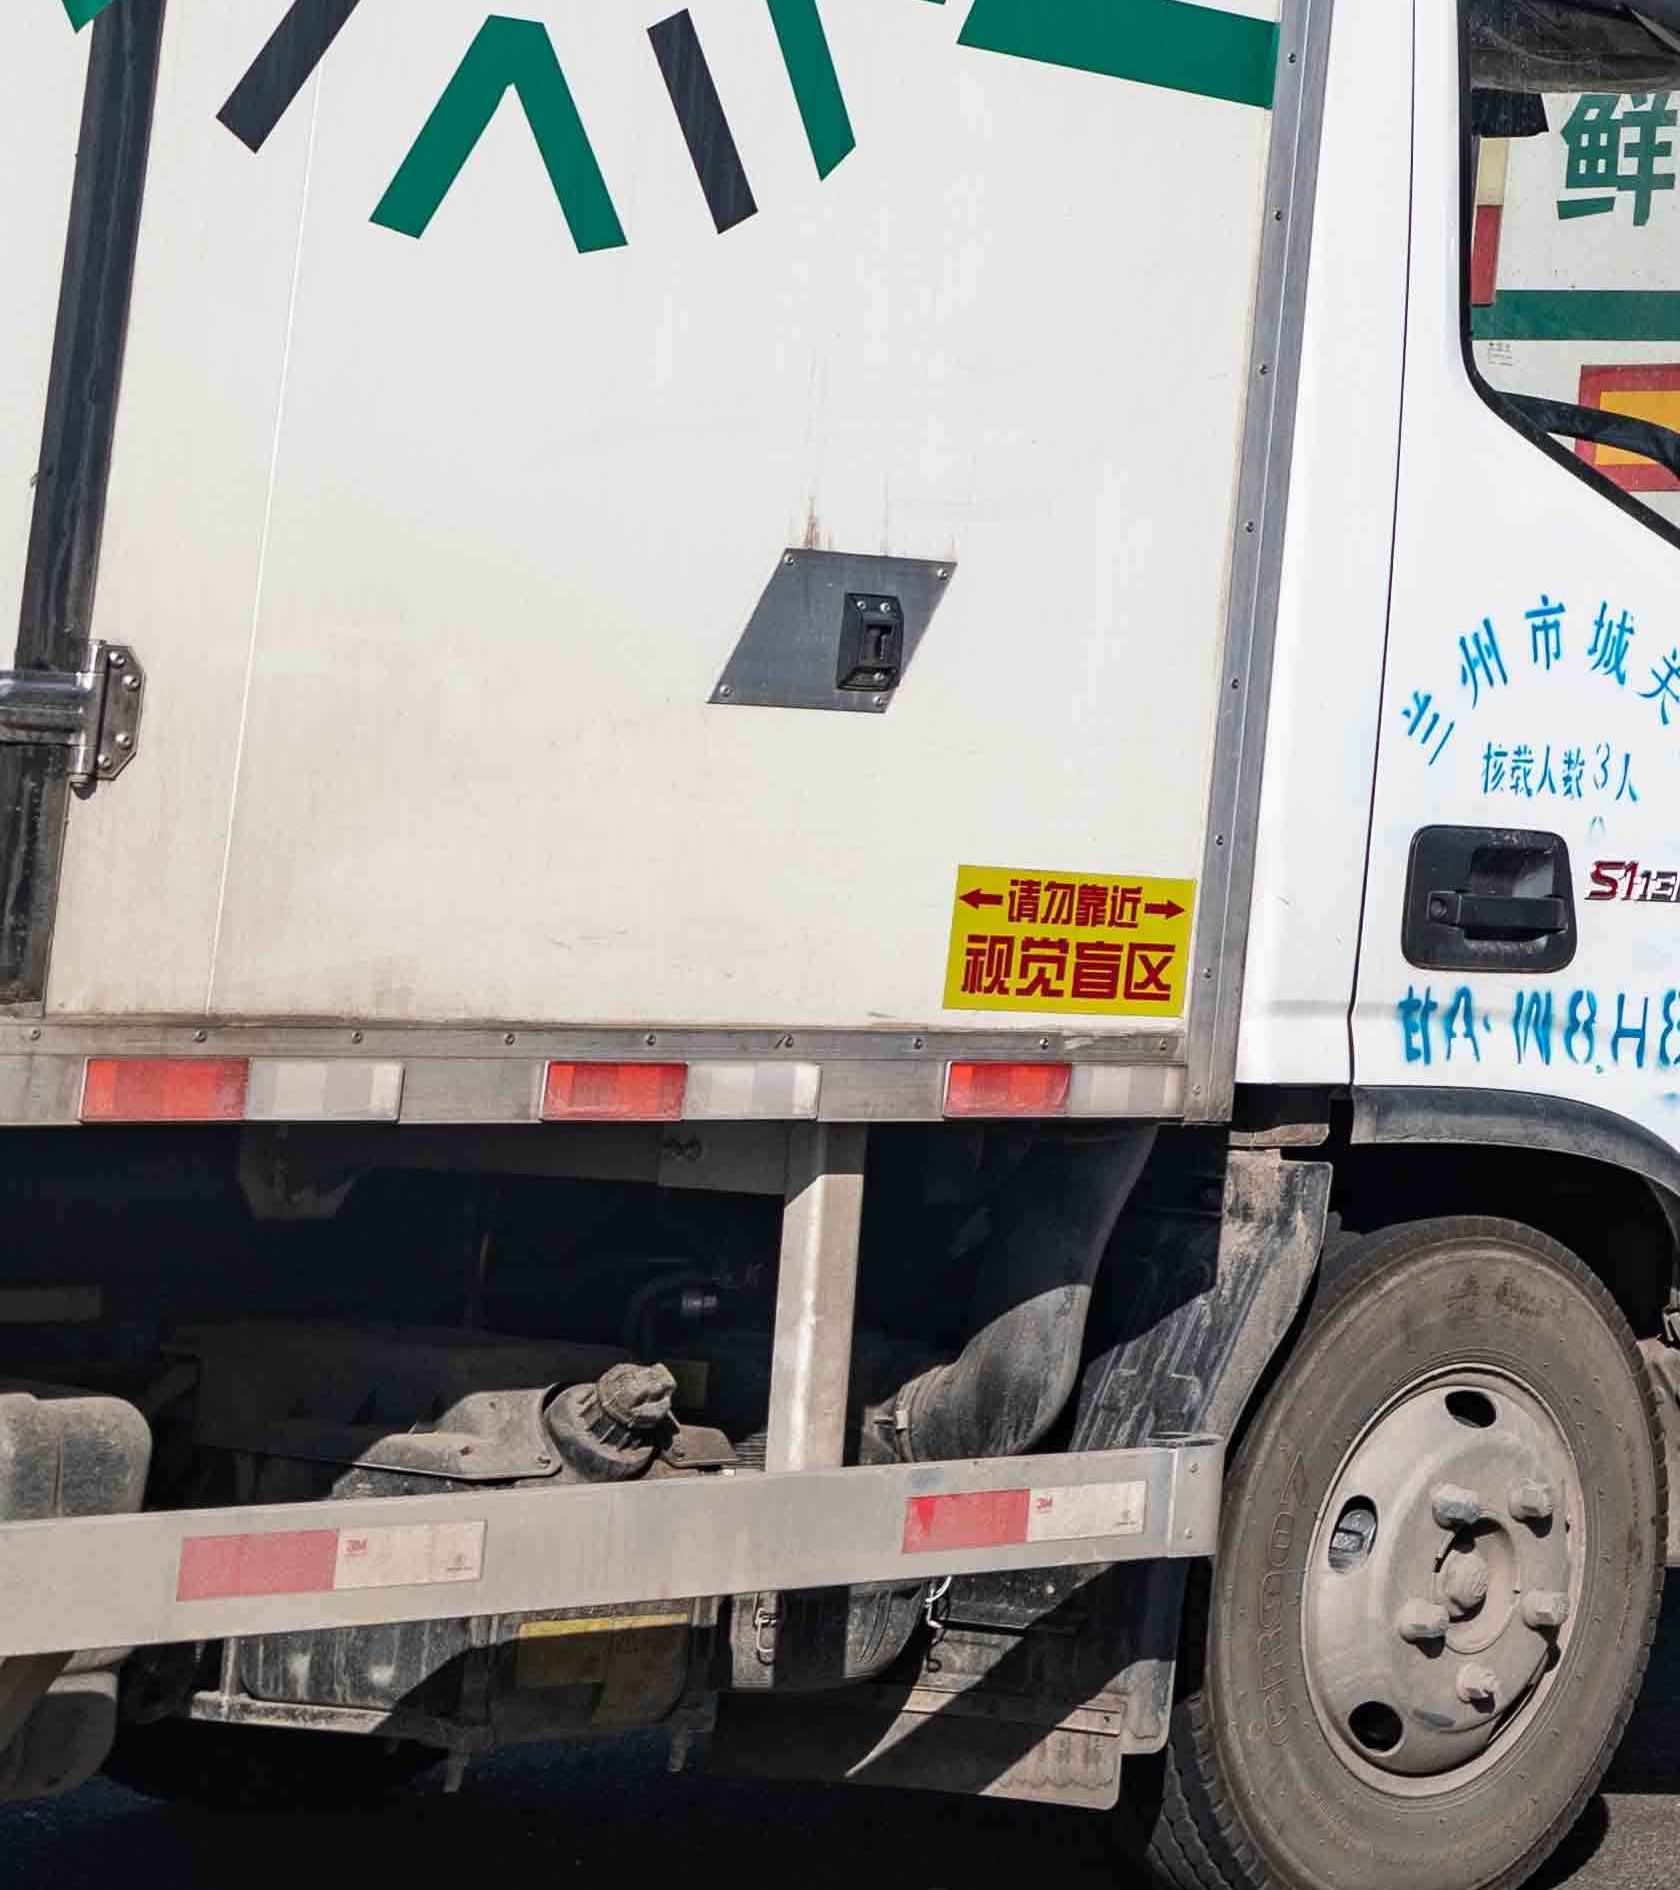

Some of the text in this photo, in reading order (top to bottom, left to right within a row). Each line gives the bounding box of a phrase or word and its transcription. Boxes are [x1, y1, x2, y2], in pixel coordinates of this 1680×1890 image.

[1007, 878, 1143, 928] 请勿靠近
[961, 933, 1176, 1002] 视觉盲区
